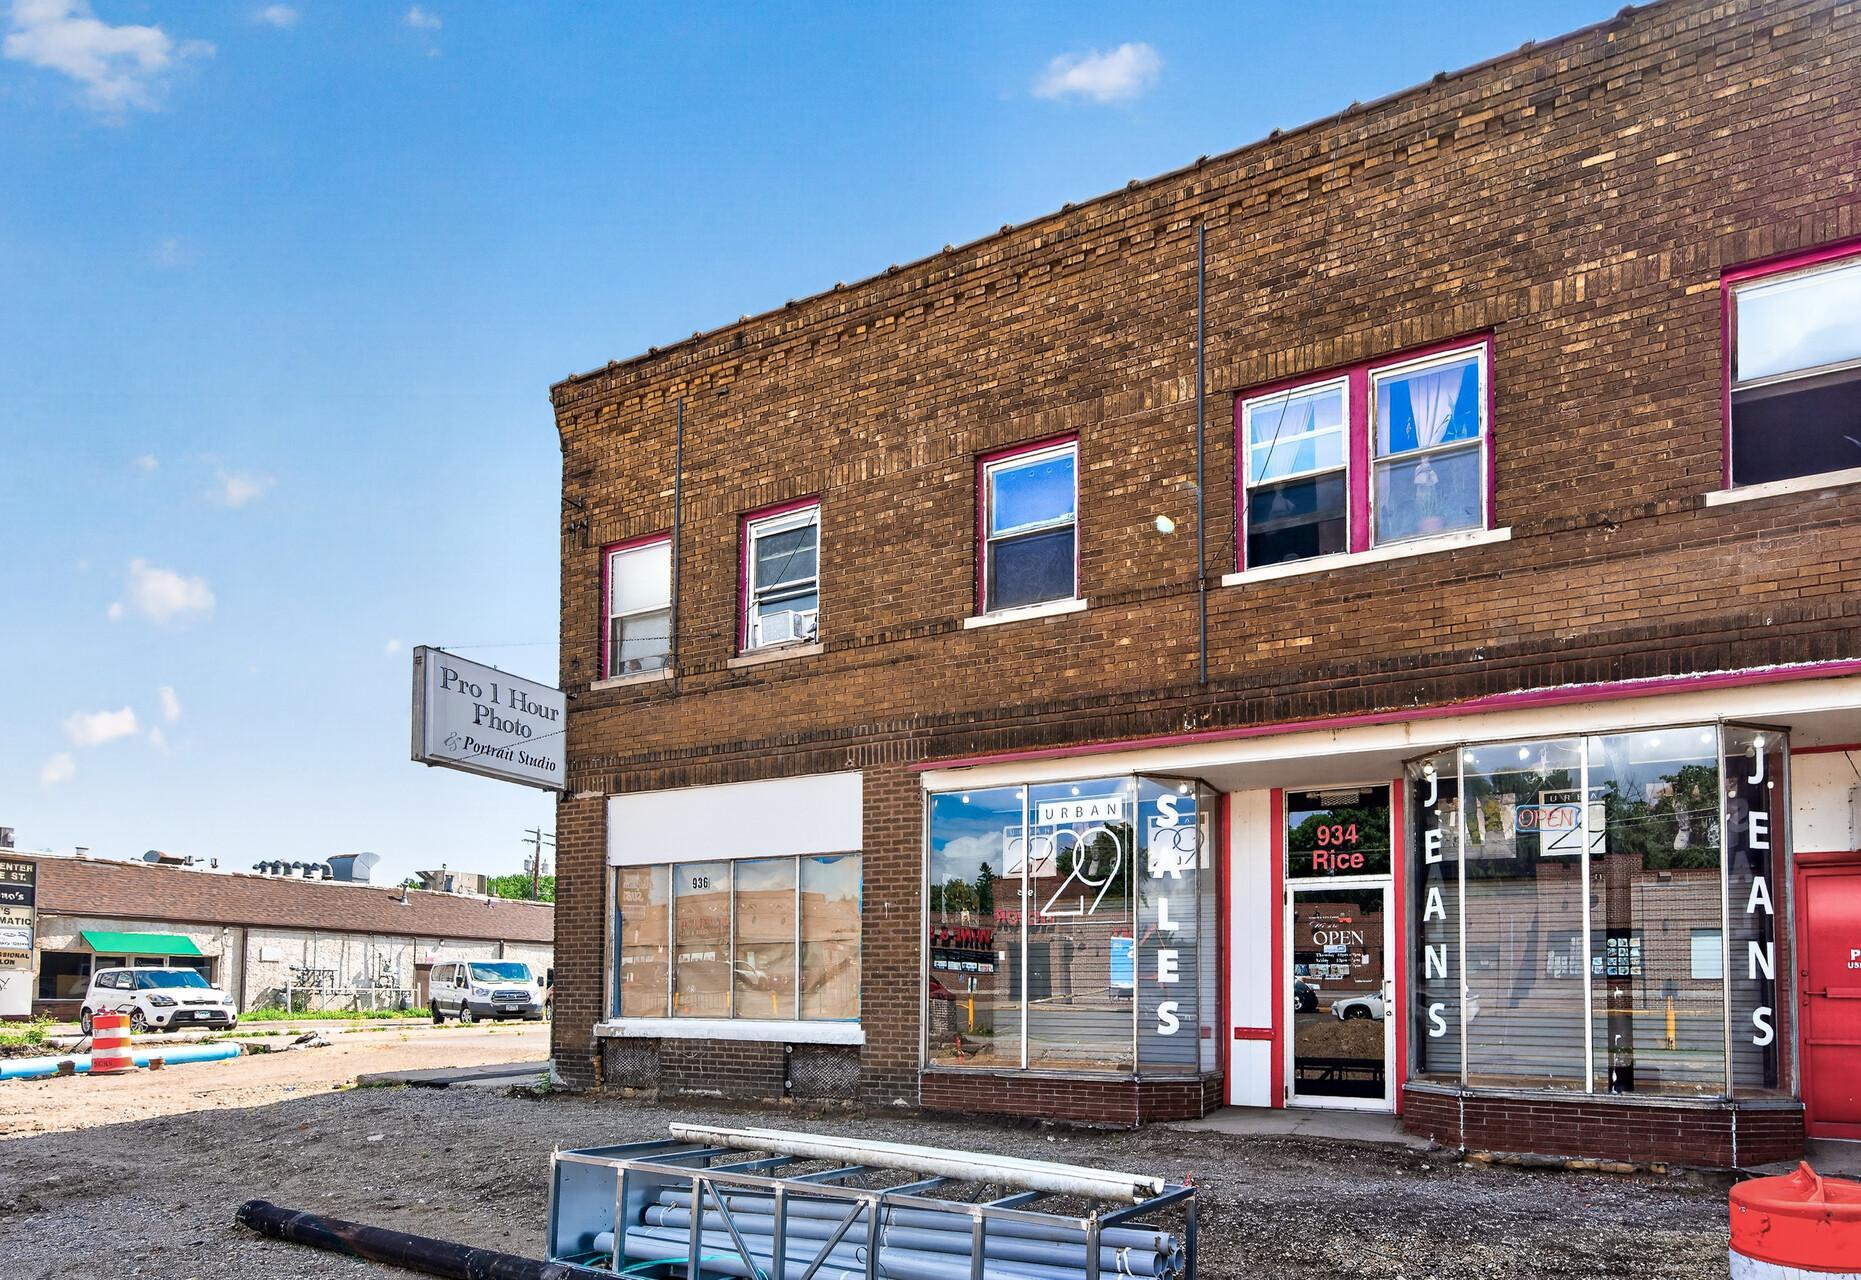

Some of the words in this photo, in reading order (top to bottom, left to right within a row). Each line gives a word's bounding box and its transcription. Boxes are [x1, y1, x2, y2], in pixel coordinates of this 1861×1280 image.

[440, 666, 482, 698] Pro
[509, 688, 559, 721] Hour
[472, 703, 532, 739] Photo
[444, 731, 461, 752] &
[463, 736, 514, 761] Portrait
[518, 750, 556, 772] Studio
[1045, 803, 1116, 820] URBAN
[1518, 809, 1573, 828] OPEN
[1317, 823, 1359, 846] 934
[1040, 826, 1121, 916] 29
[1312, 849, 1365, 870] Rice
[692, 877, 708, 889] 936
[1747, 746, 1775, 1046] JEANS
[1152, 794, 1180, 1035] SALES
[1424, 772, 1448, 1038] JEANS
[1313, 930, 1364, 946] OPEN
